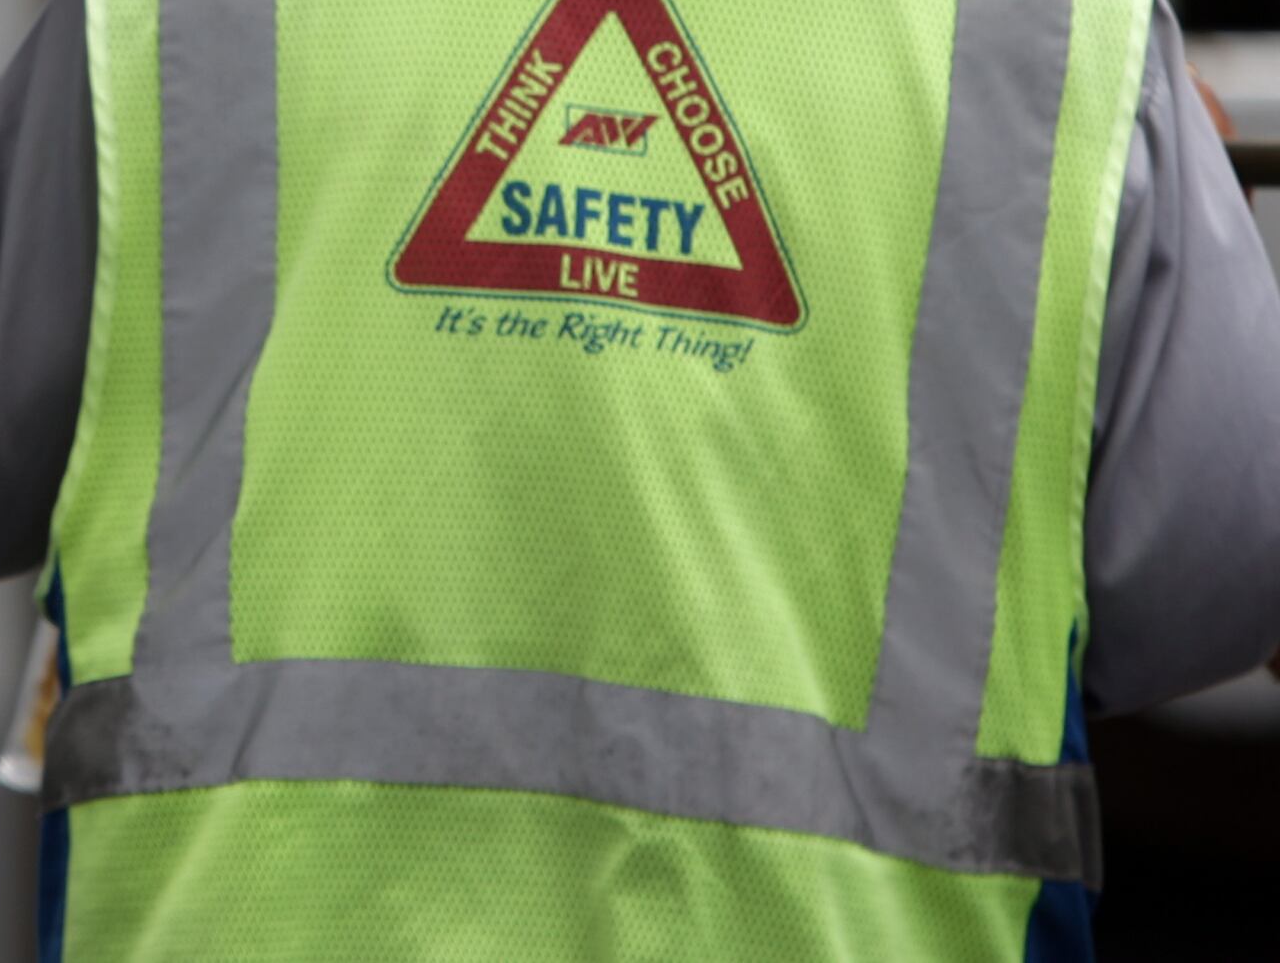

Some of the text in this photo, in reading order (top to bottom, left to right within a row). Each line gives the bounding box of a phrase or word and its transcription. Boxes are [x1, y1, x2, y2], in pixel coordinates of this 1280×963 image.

[476, 48, 564, 161] THINK
[646, 41, 749, 209] CHOOSE
[500, 180, 705, 255] SAFETY
[560, 253, 639, 297] LIVE
[435, 306, 755, 373] It's the Right Thing!
